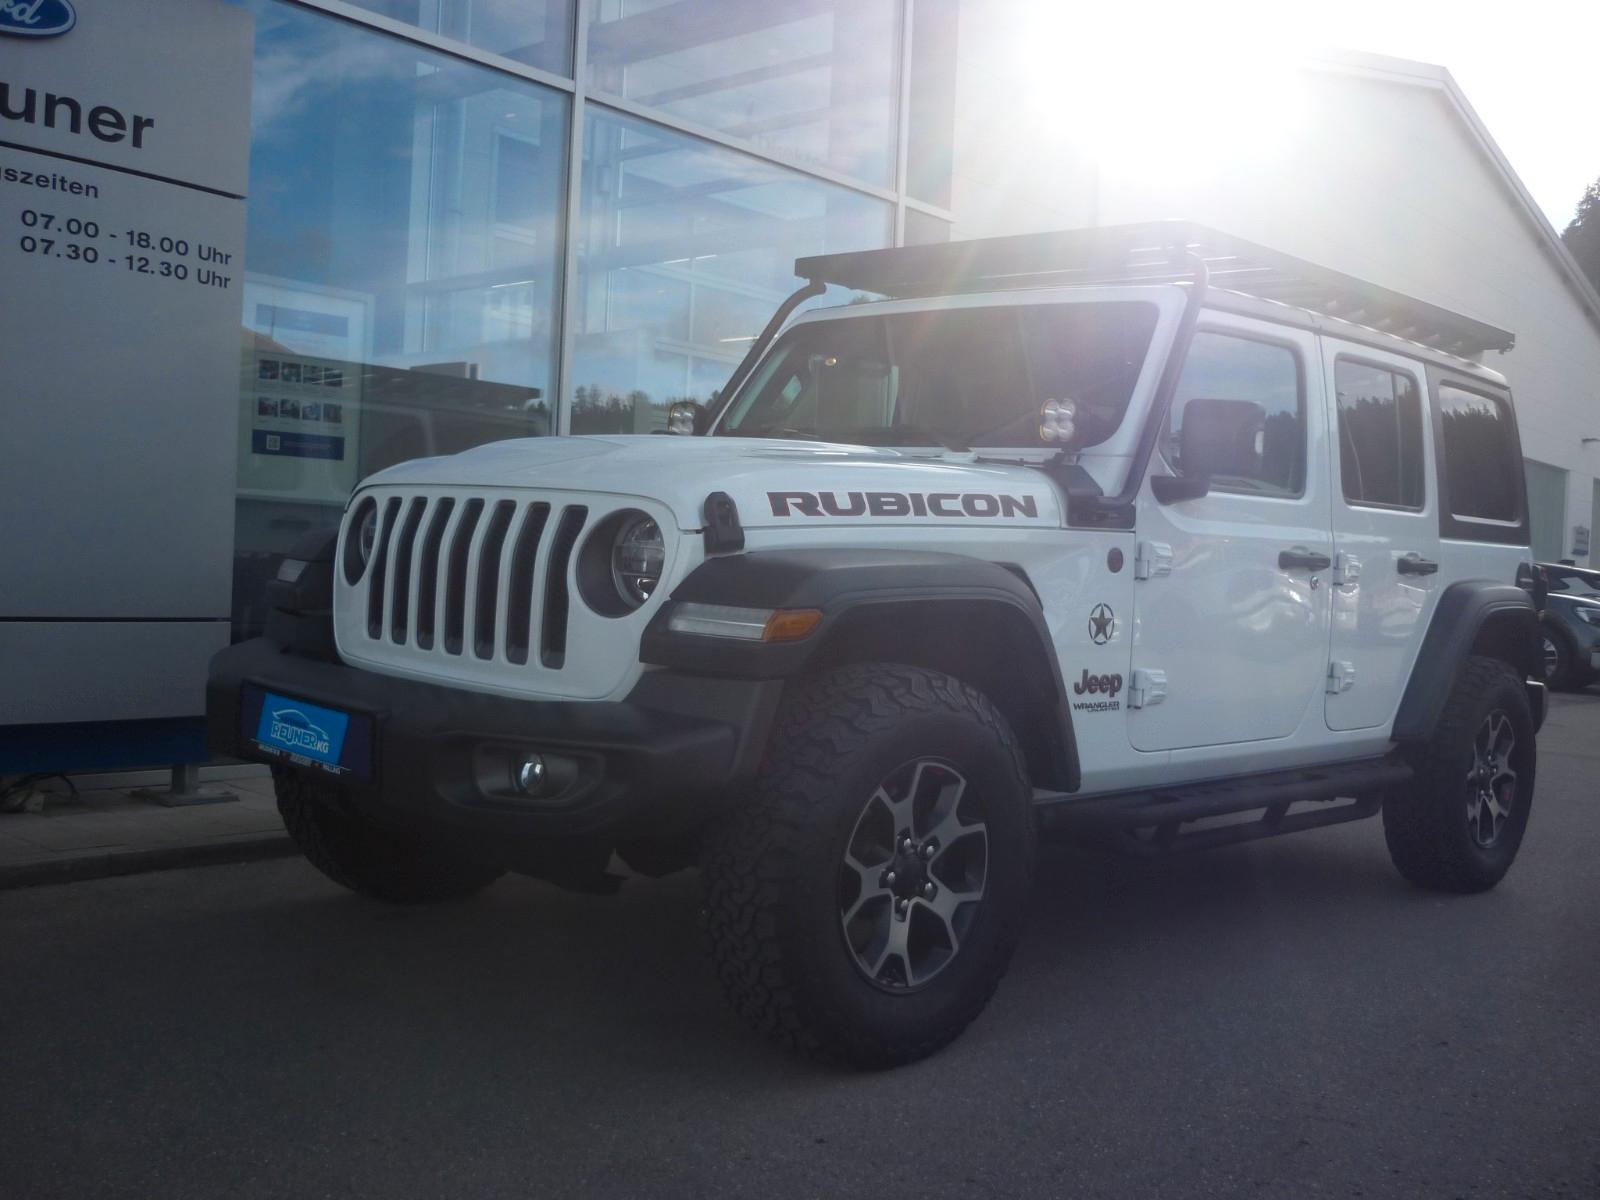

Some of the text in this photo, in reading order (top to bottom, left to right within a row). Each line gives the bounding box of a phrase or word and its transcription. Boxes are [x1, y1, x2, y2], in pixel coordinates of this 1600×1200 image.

[0, 167, 99, 199] szeiten
[21, 210, 99, 238] 07.00
[126, 230, 188, 256] 18.00
[198, 244, 232, 265] Uhr
[20, 236, 98, 263] 07.30
[125, 255, 188, 280] 12.30
[197, 268, 231, 288] Uhr
[766, 491, 1038, 518] RUBICON
[1073, 669, 1123, 698] Jeep
[1073, 701, 1120, 711] WRANGLER
